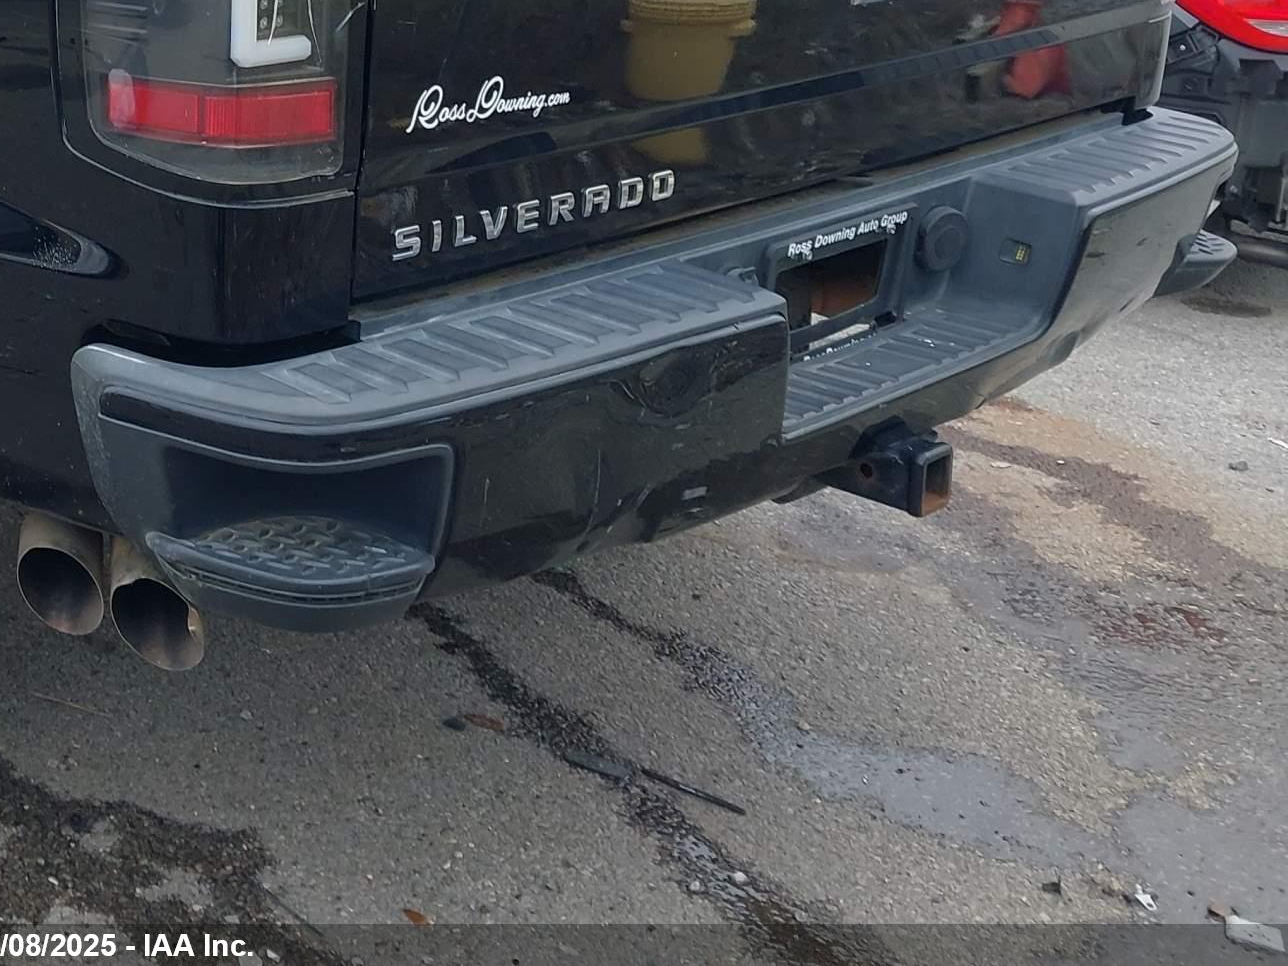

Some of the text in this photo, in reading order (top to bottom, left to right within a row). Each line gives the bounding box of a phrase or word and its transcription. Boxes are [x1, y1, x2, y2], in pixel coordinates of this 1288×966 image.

[391, 169, 676, 262] SILVERADO
[787, 211, 908, 257] Ross Downing Auto Group
